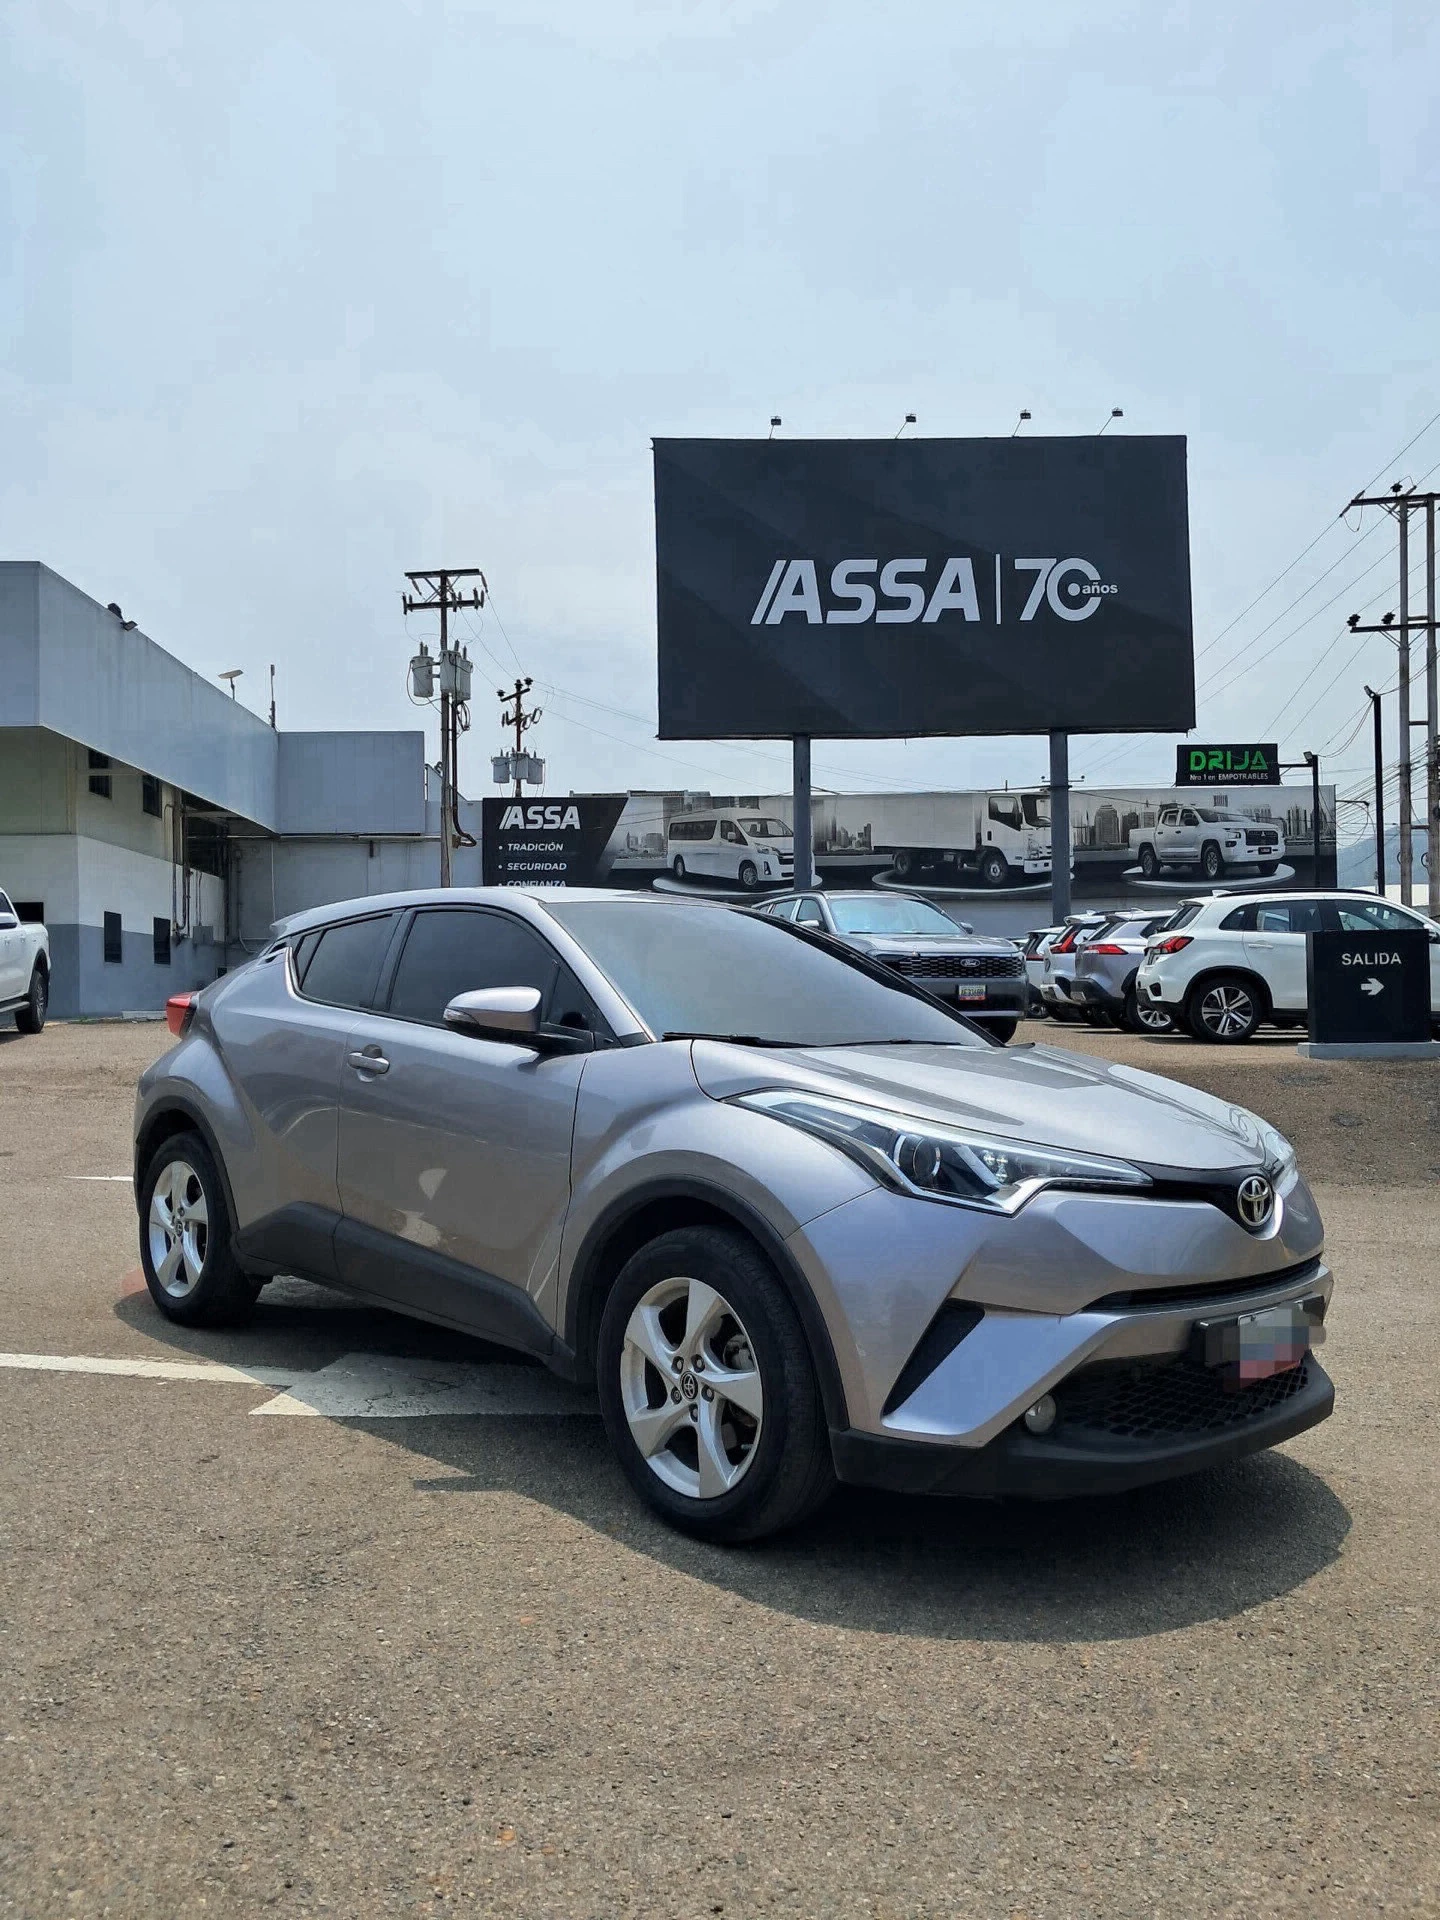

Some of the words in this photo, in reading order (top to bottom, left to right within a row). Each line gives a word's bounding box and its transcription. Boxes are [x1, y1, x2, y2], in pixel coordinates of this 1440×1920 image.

[751, 558, 980, 625] ASSA
[1015, 557, 1102, 621] 70
[1082, 582, 1118, 594] años
[1190, 750, 1268, 771] DRIJA
[499, 805, 580, 830] ASSA
[507, 842, 564, 852] TRADICIÓN
[507, 862, 567, 871] SEGURIDAD
[1341, 952, 1402, 965] SALIDA
